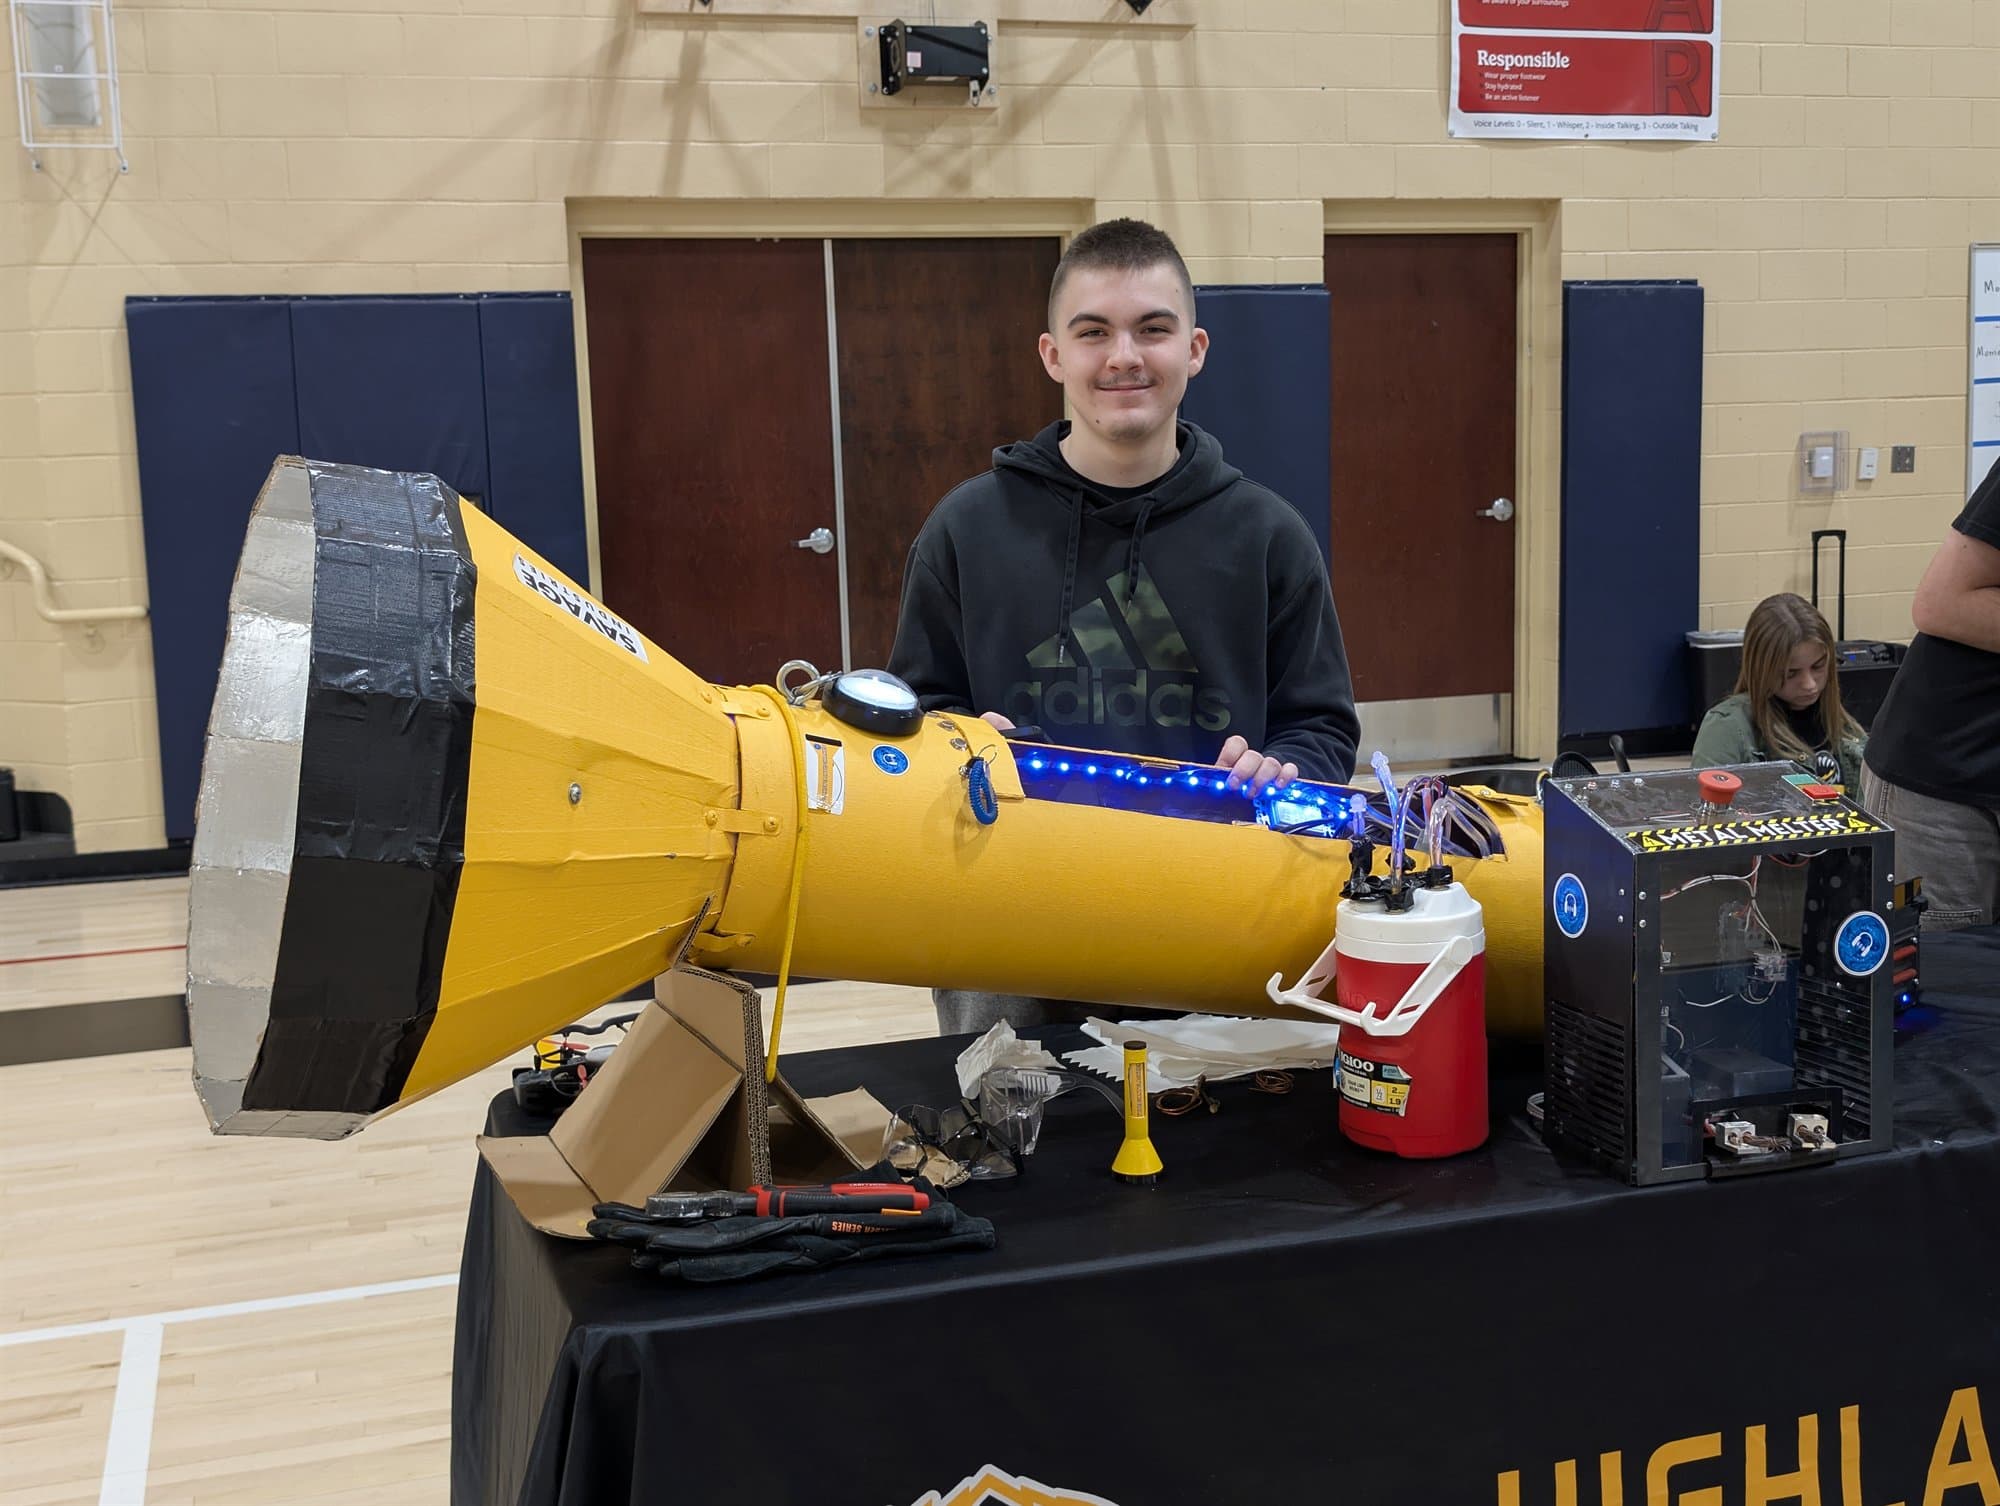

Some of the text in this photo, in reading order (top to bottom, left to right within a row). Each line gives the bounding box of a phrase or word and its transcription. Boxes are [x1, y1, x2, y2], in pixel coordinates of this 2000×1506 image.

[1477, 50, 1571, 71] Responsible
[1520, 72, 1546, 80] footwear
[1484, 82, 1522, 92] Stay hydrated
[1473, 120, 1492, 128] Voice
[1595, 121, 1615, 129] Inside
[1652, 121, 1679, 129] Outside
[518, 555, 631, 634] INDUSTRIES
[521, 568, 637, 654] SAVAGE
[1004, 666, 1232, 732] adidas
[1658, 818, 1848, 846] METAL MELTER
[1340, 1051, 1374, 1072] IGLOO
[831, 1220, 863, 1233] SERIES
[1498, 1386, 2000, 1506] GHLA
